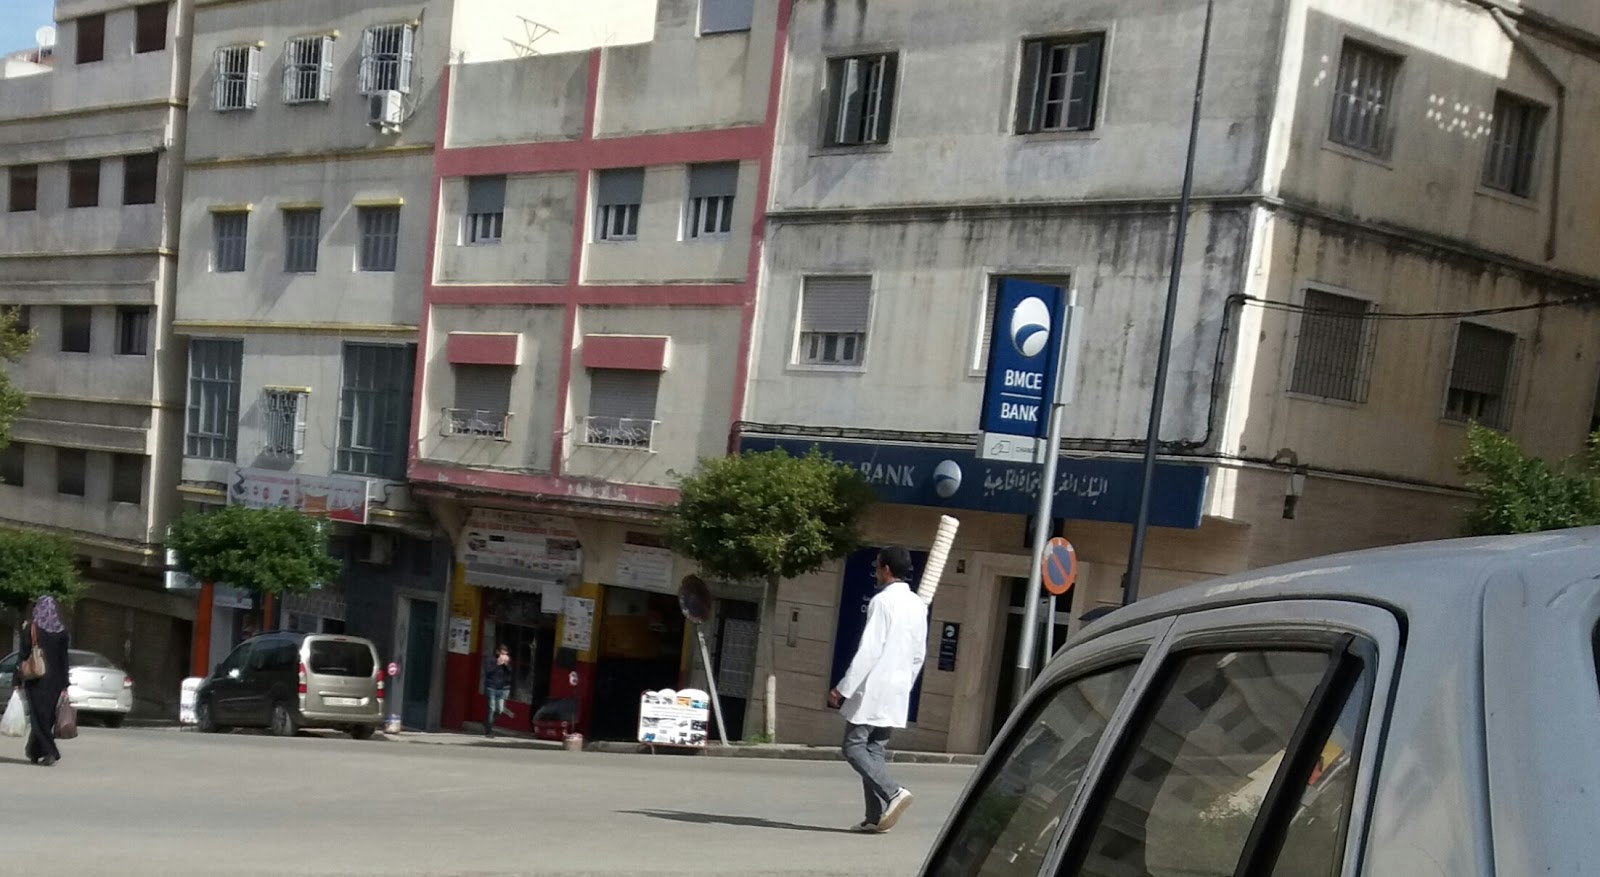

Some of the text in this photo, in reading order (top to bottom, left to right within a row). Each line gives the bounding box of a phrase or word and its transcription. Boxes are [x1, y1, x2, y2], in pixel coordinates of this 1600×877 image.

[1004, 369, 1043, 390] BMCE
[1000, 402, 1039, 422] BANK
[860, 461, 915, 487] BANK
